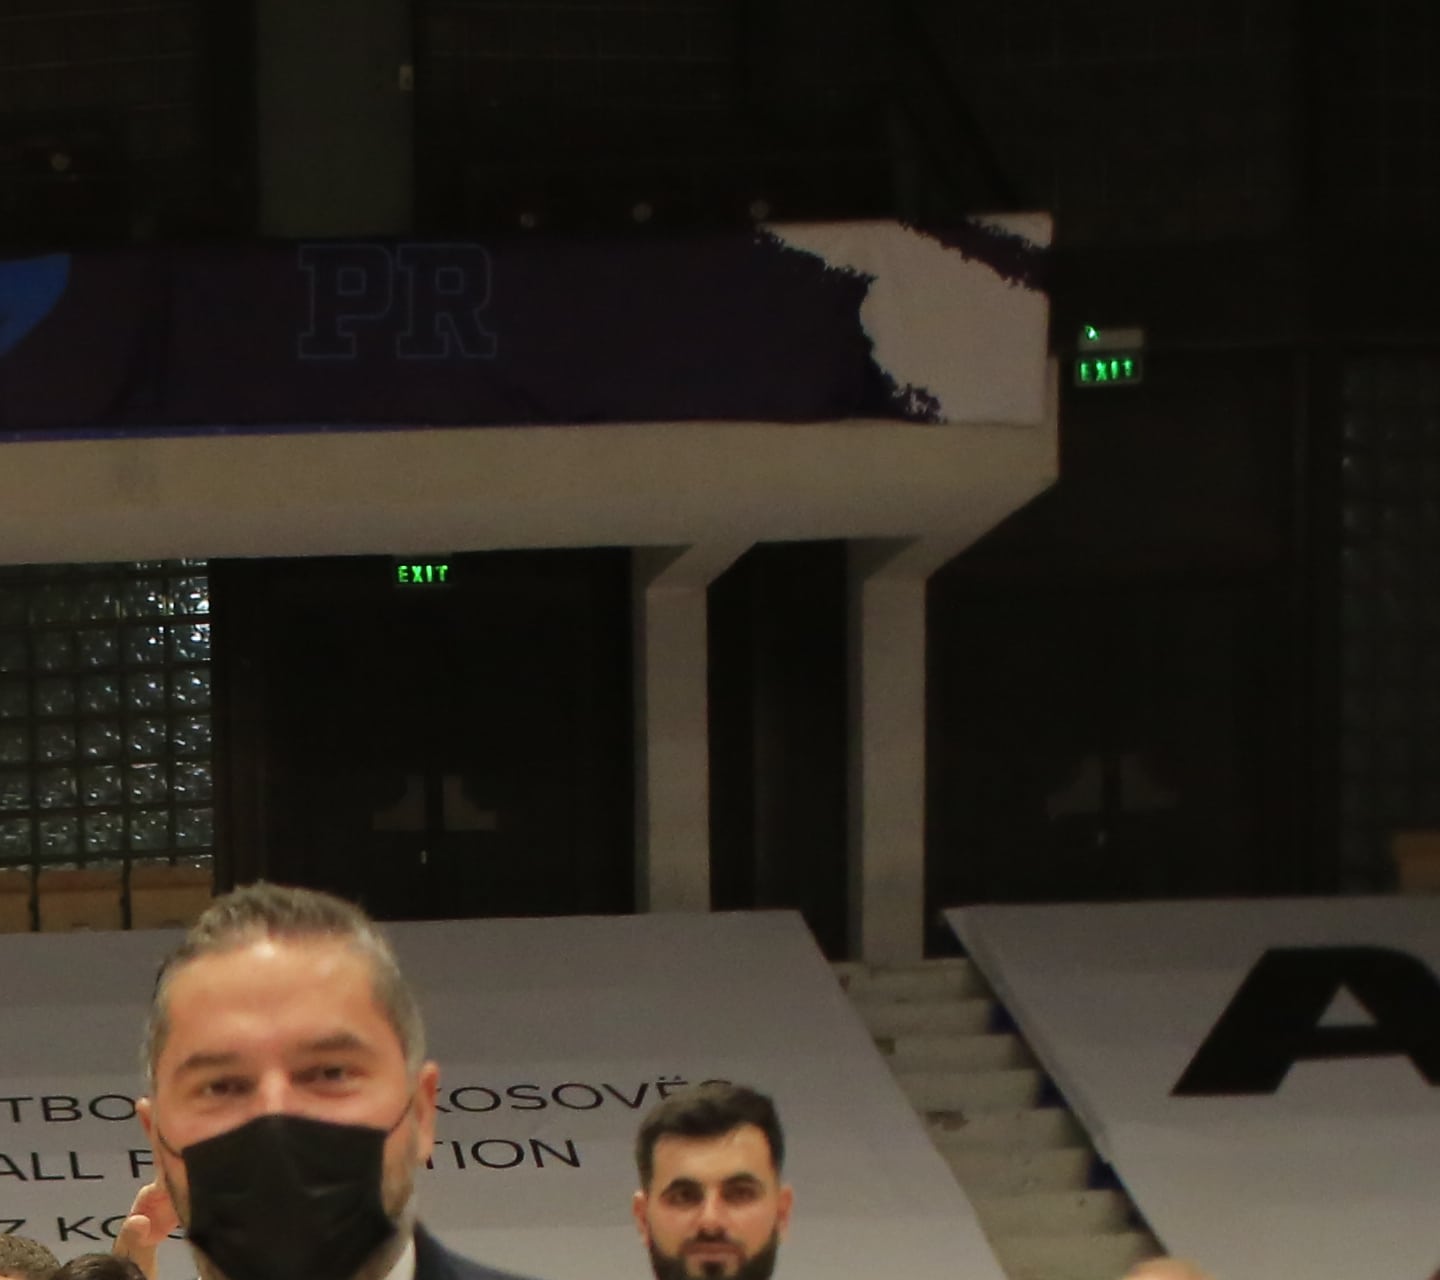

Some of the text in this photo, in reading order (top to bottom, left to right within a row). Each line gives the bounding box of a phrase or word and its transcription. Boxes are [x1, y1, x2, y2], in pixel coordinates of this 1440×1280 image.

[296, 242, 498, 360] PR
[397, 564, 449, 583] EXIT
[434, 1075, 733, 1113] OSOVË
